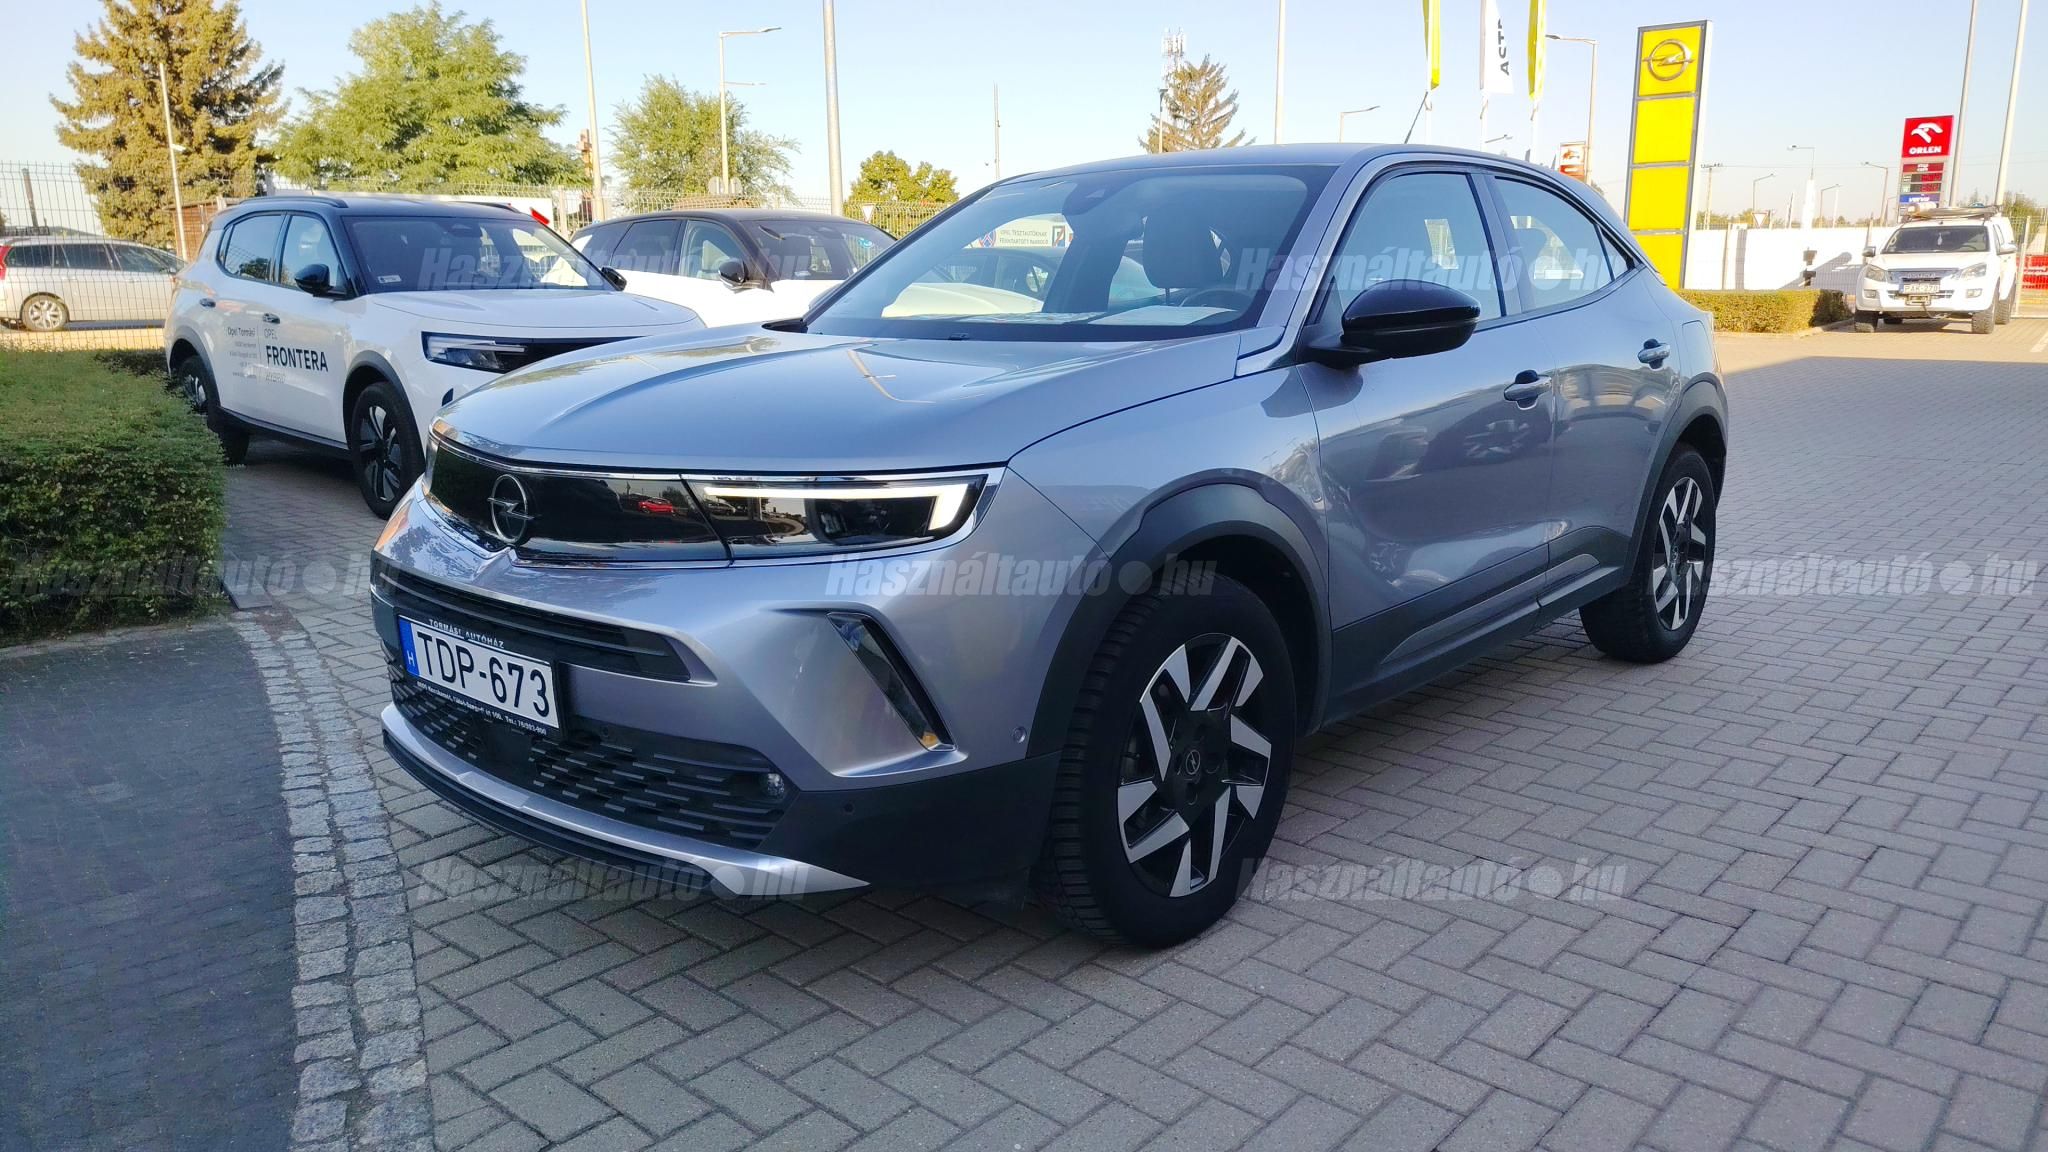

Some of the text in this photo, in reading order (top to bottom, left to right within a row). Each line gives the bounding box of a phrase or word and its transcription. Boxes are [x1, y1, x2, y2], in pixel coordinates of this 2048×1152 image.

[1909, 146, 1942, 155] ORLEN
[265, 345, 329, 373] FRONTERA
[465, 631, 505, 649] AUTÓHÁZ
[407, 650, 416, 667] H
[417, 631, 550, 718] TDP-673
